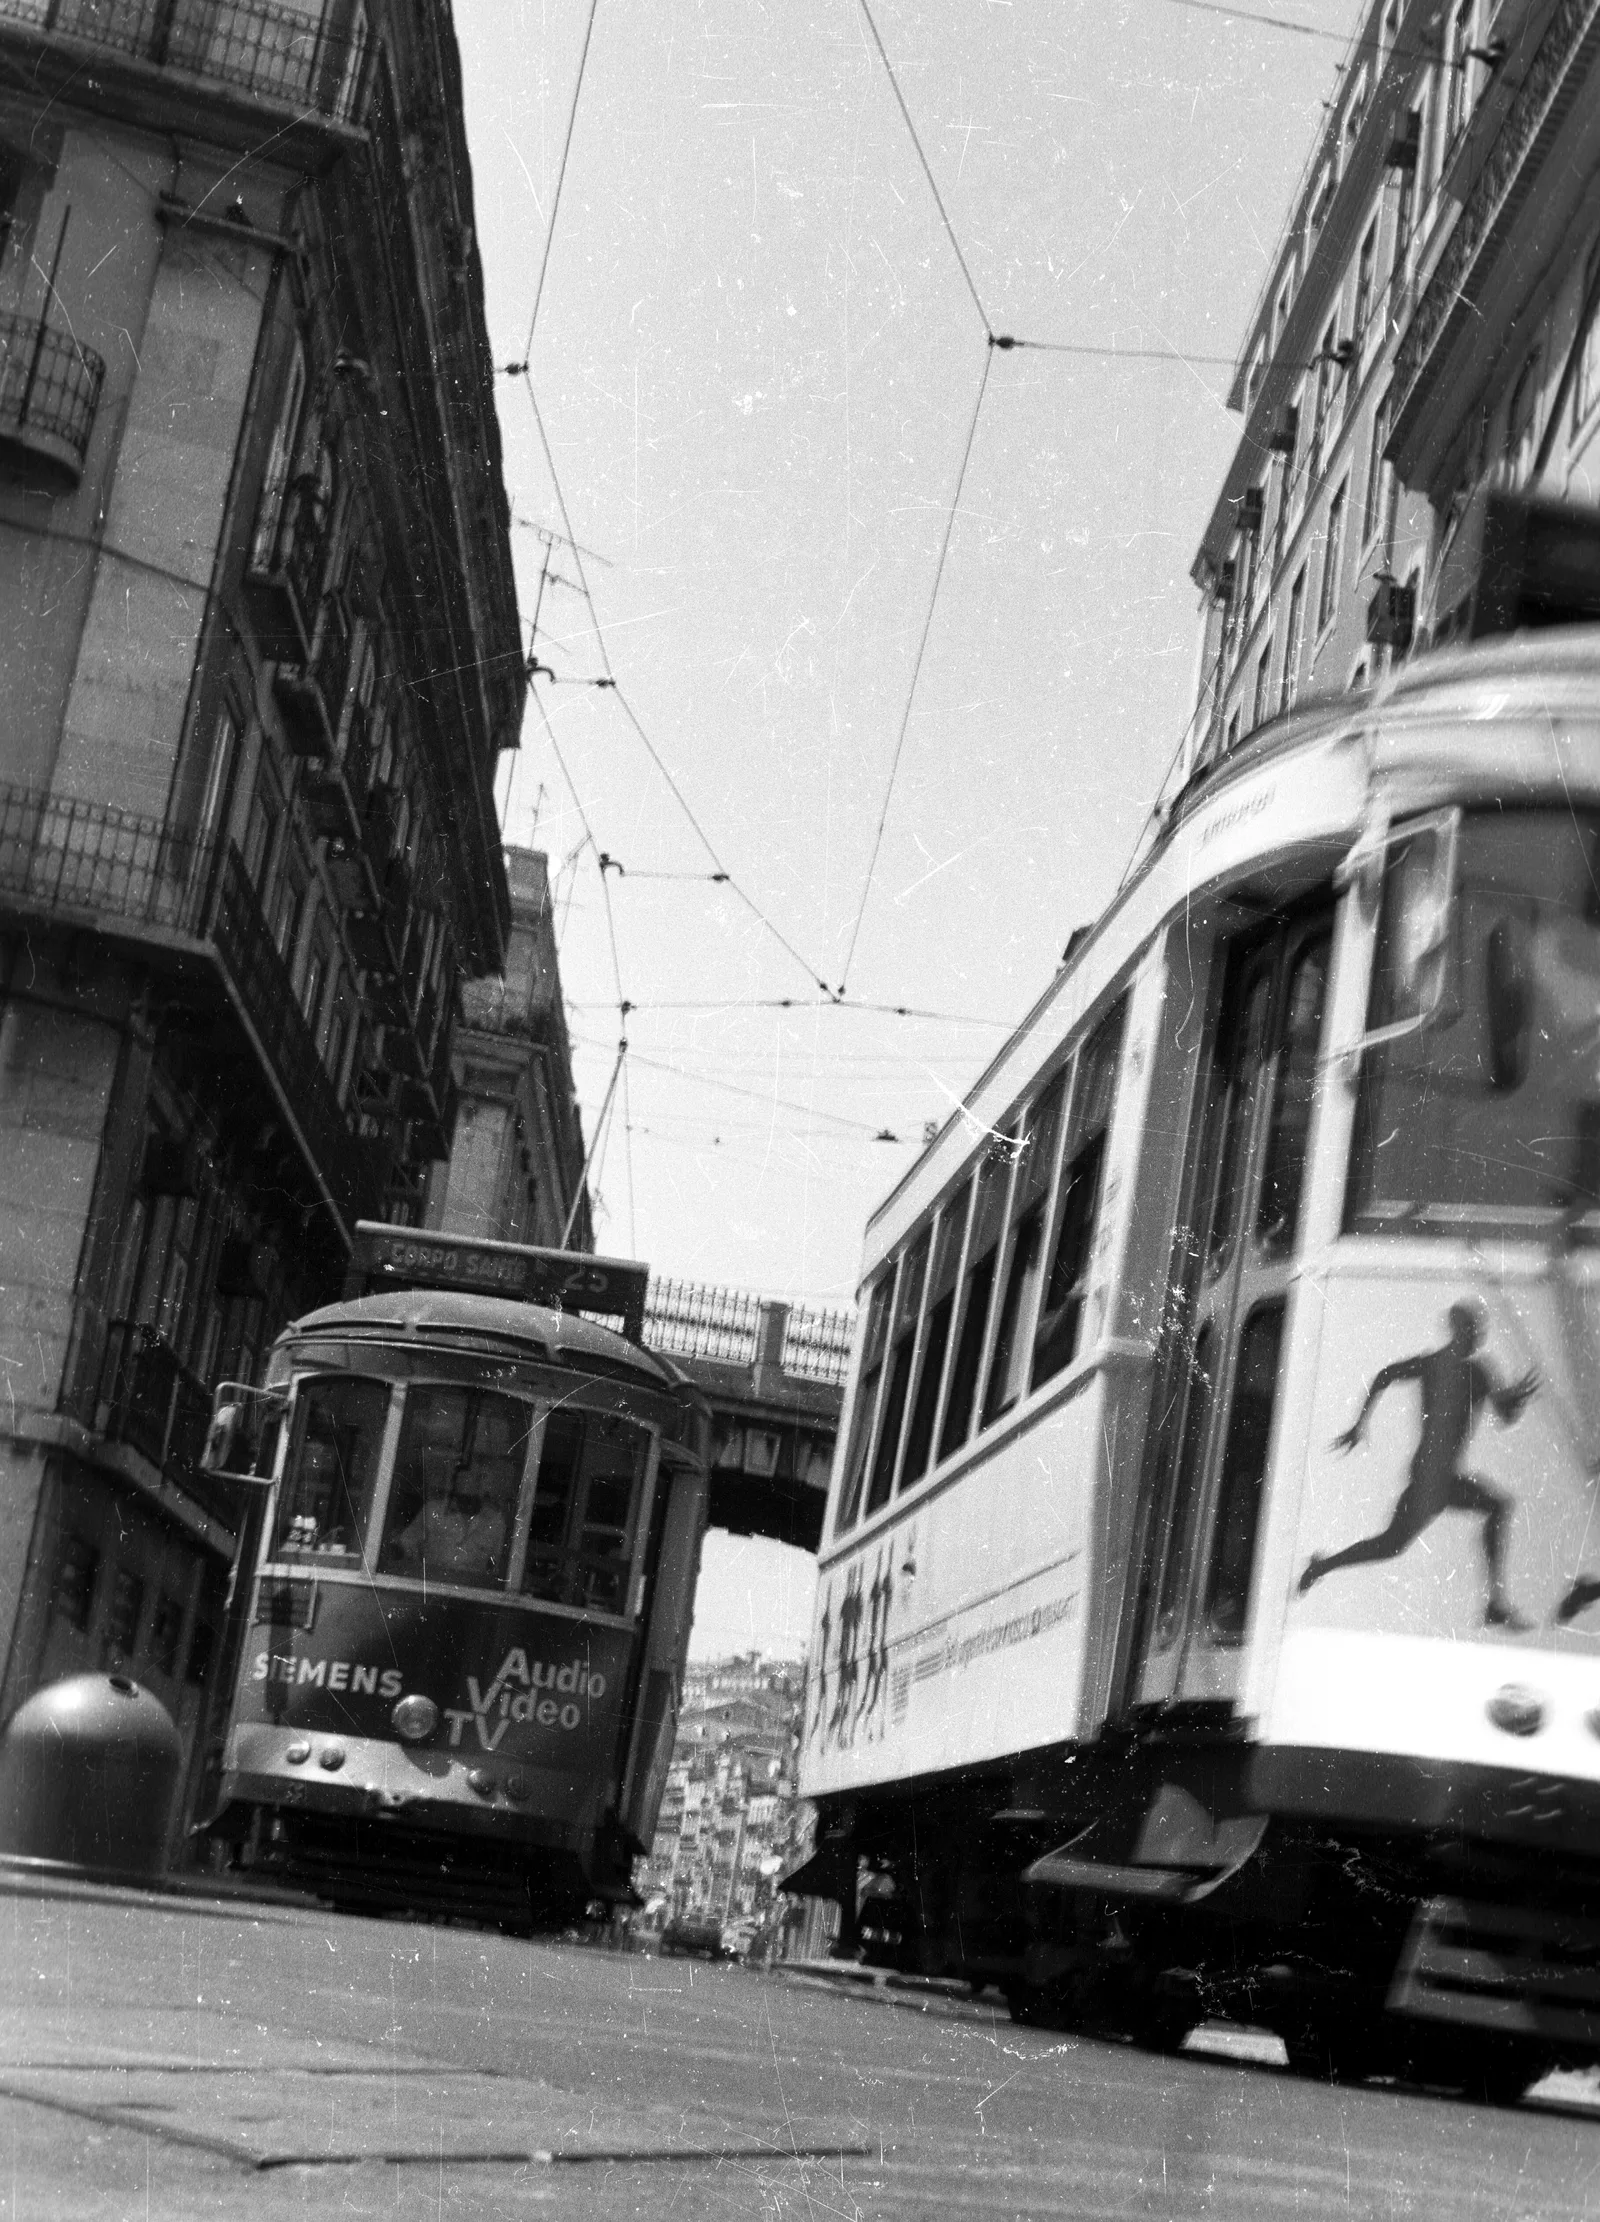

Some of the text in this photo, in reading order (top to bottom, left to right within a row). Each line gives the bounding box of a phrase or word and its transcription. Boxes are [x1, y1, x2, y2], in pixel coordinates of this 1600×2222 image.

[390, 1243, 458, 1272] CORPO
[252, 1651, 403, 1697] SIEMENS
[496, 1647, 606, 1699] Audio
[467, 1676, 581, 1730] Video
[444, 1708, 510, 1750] TV
